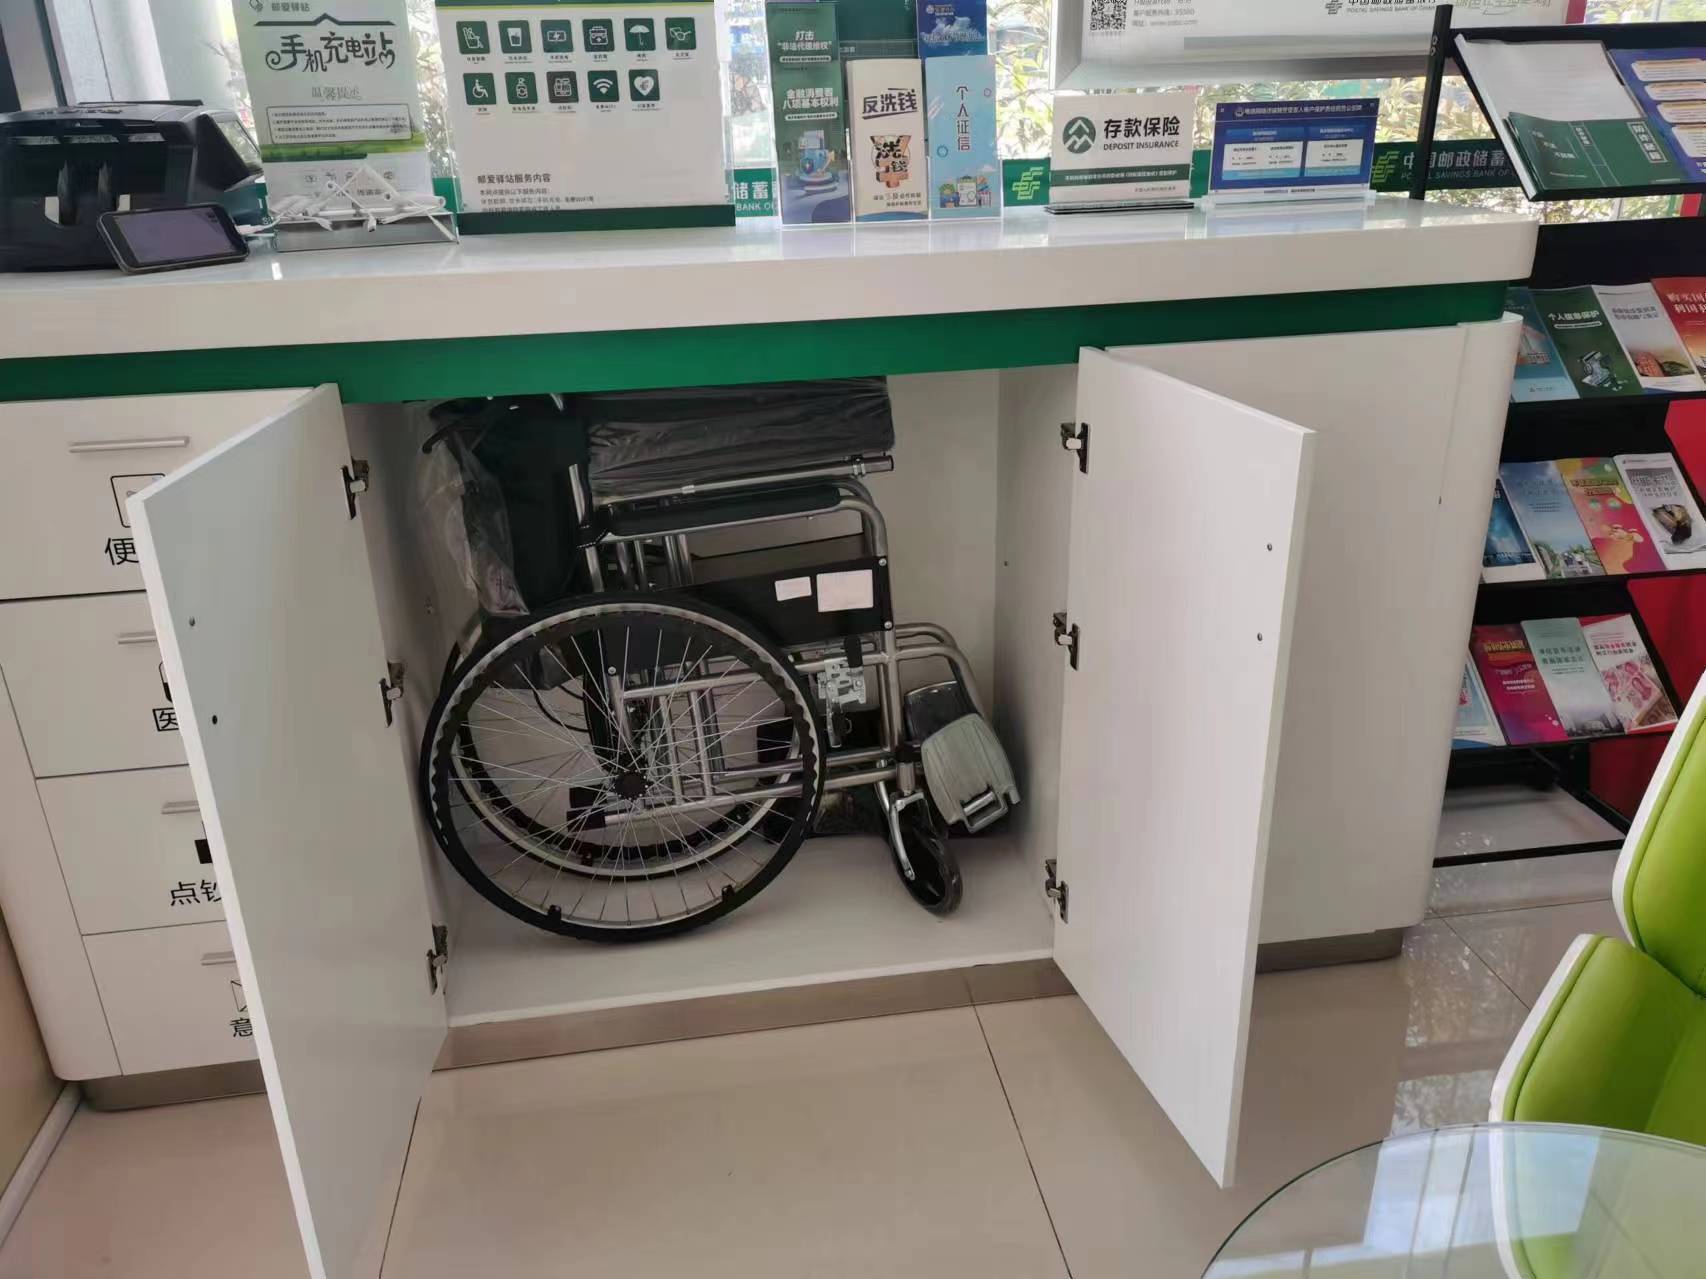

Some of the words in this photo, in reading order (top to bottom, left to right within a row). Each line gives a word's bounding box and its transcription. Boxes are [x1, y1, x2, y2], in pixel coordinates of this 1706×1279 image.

[265, 31, 396, 73] 手机充电站
[862, 88, 918, 114] 反洗钱
[956, 86, 971, 151] 个人征信
[1103, 116, 1181, 139] 存款保险
[1103, 141, 1134, 151] DEPOSIT
[1136, 140, 1180, 149] INSURANCE
